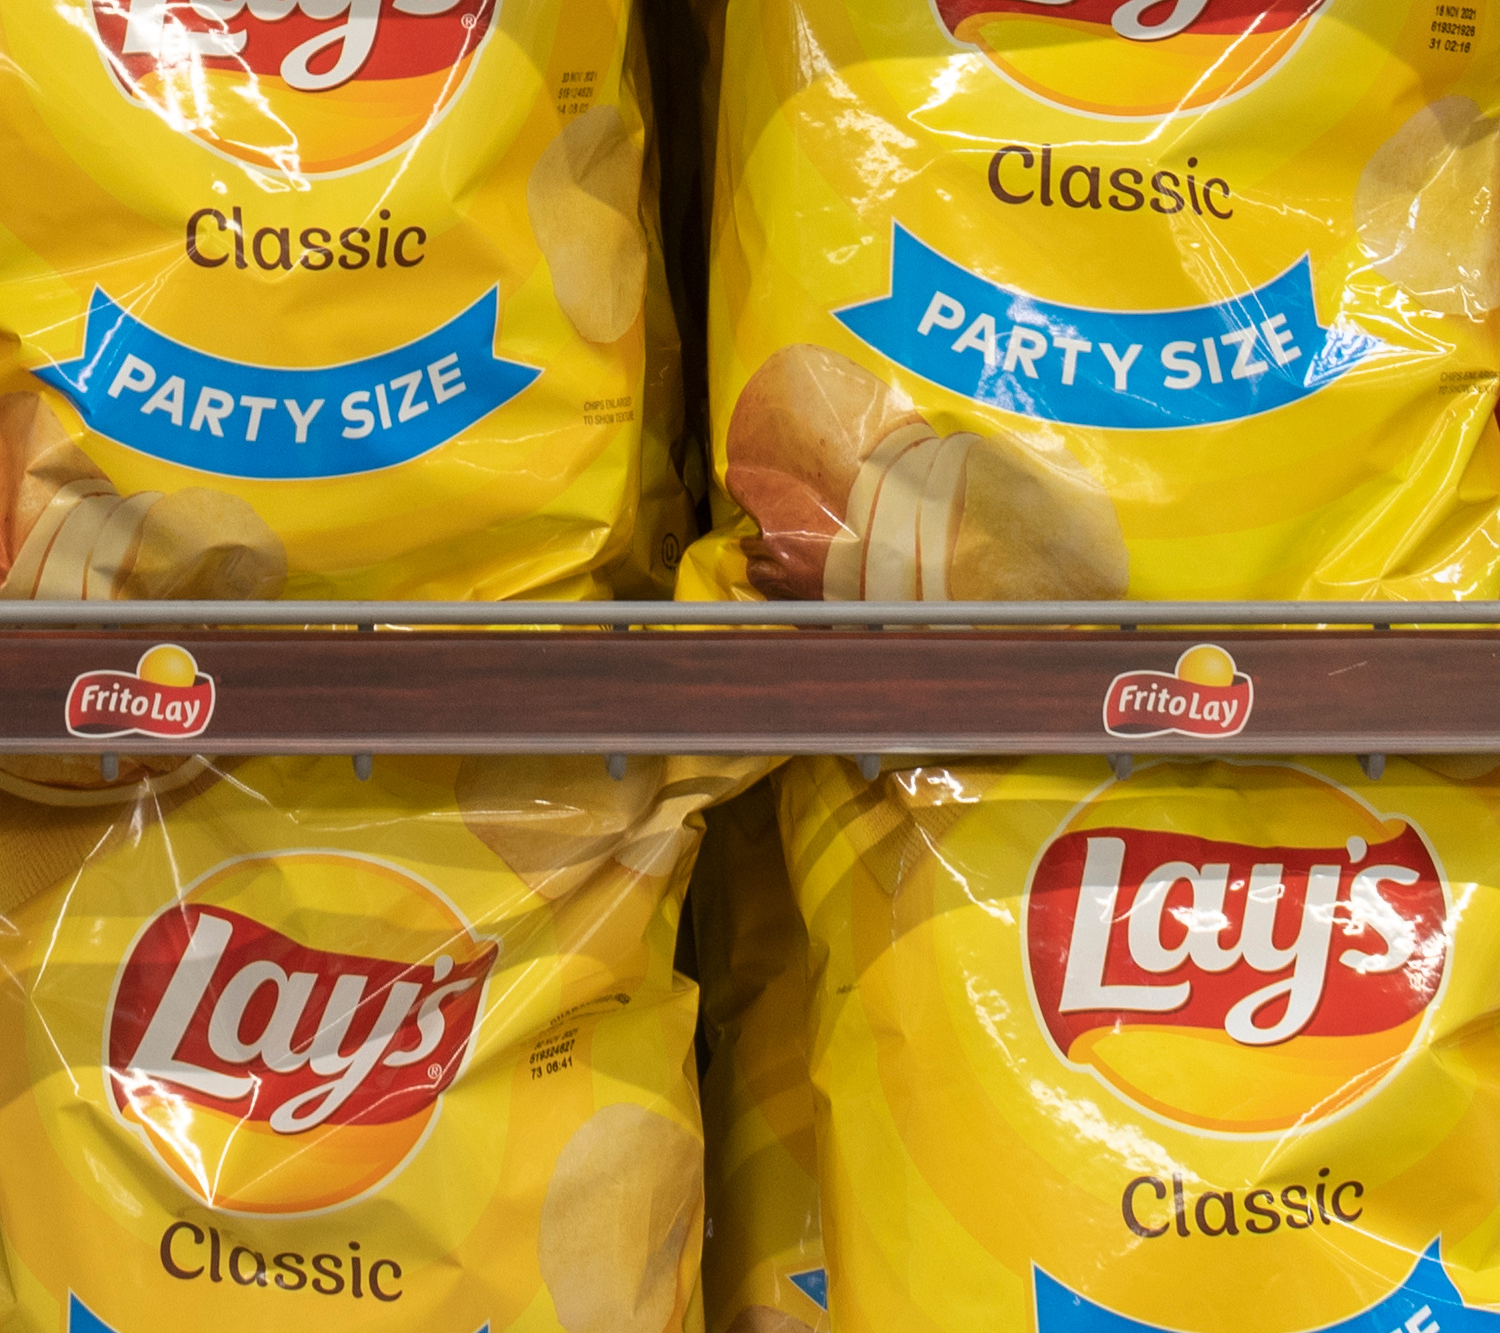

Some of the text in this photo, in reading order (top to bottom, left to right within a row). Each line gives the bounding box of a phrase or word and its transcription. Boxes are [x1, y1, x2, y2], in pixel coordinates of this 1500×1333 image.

[988, 145, 1234, 220] Classic
[186, 208, 427, 271] Classic
[917, 290, 1302, 392] PARTY SIZE
[107, 352, 466, 443] PARTY SIZE
[583, 399, 604, 410] CHIPS
[1059, 836, 1418, 1045] Lay's
[128, 912, 476, 1134] Lay's
[1121, 1167, 1365, 1239] Classic
[159, 1223, 404, 1302] Classic
